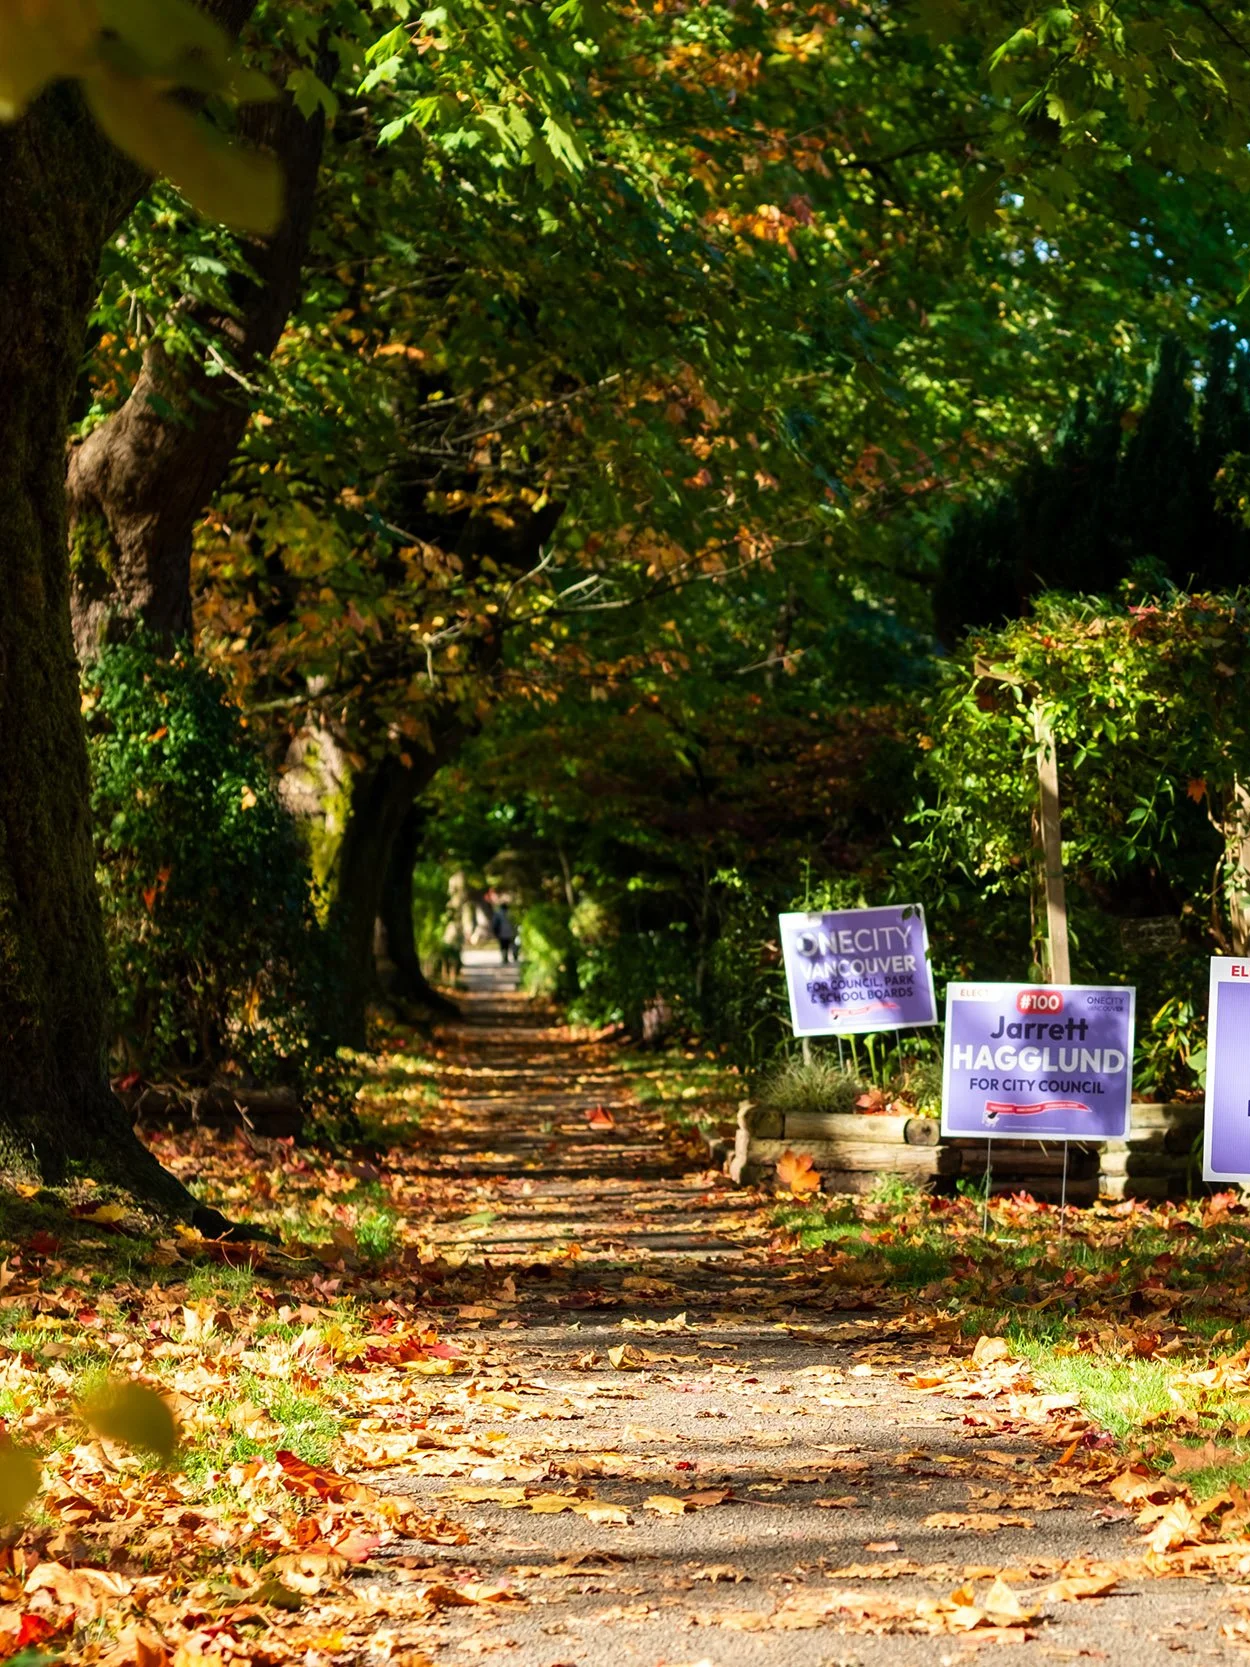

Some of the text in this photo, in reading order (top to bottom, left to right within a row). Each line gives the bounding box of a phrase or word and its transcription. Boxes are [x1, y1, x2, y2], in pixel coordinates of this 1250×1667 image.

[796, 925, 912, 957] ONECITY
[799, 955, 916, 979] VANCOUVER
[807, 981, 829, 993] FOR
[884, 974, 915, 986] PARK
[960, 988, 989, 997] ELECT
[819, 990, 865, 1004] SCHOOL
[868, 987, 913, 999] BOARDS
[1020, 994, 1059, 1010] #100
[1087, 996, 1124, 1005] ONECITY
[990, 1015, 1088, 1041] Jarrett
[952, 1044, 1125, 1074] HAGGLUND
[970, 1078, 1104, 1094] FOR CITY COUNCIL
